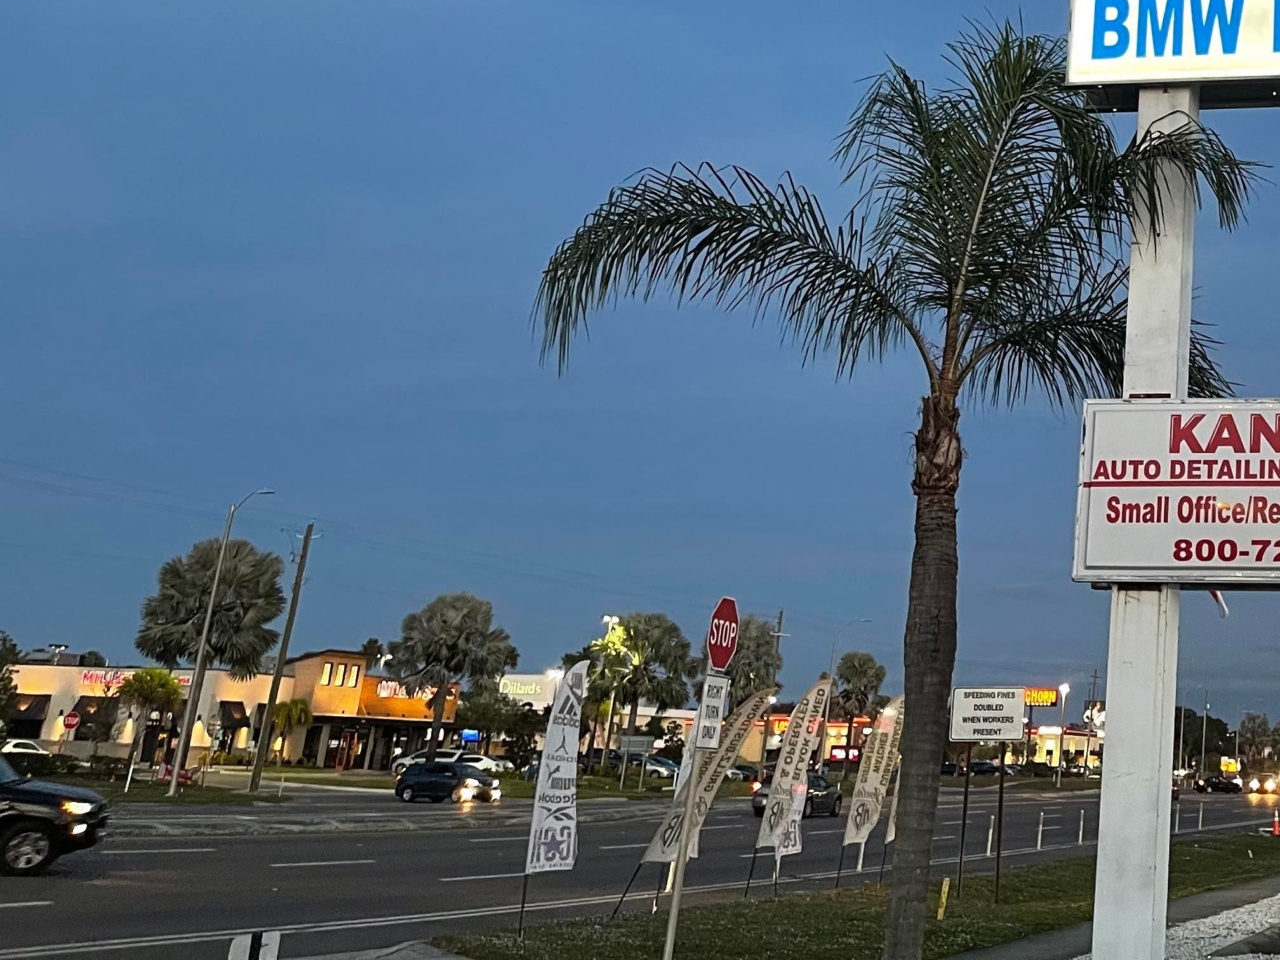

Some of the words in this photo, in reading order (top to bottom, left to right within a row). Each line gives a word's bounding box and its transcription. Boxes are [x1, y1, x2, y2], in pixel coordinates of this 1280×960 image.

[1093, 460, 1161, 480] AUTO
[1106, 495, 1170, 524] Small
[710, 618, 737, 647] STOP
[707, 684, 723, 699] RIGHT
[705, 705, 719, 720] TURN
[64, 716, 80, 725] STOP
[702, 725, 716, 740] ONLY
[972, 728, 1002, 736] PRESENT
